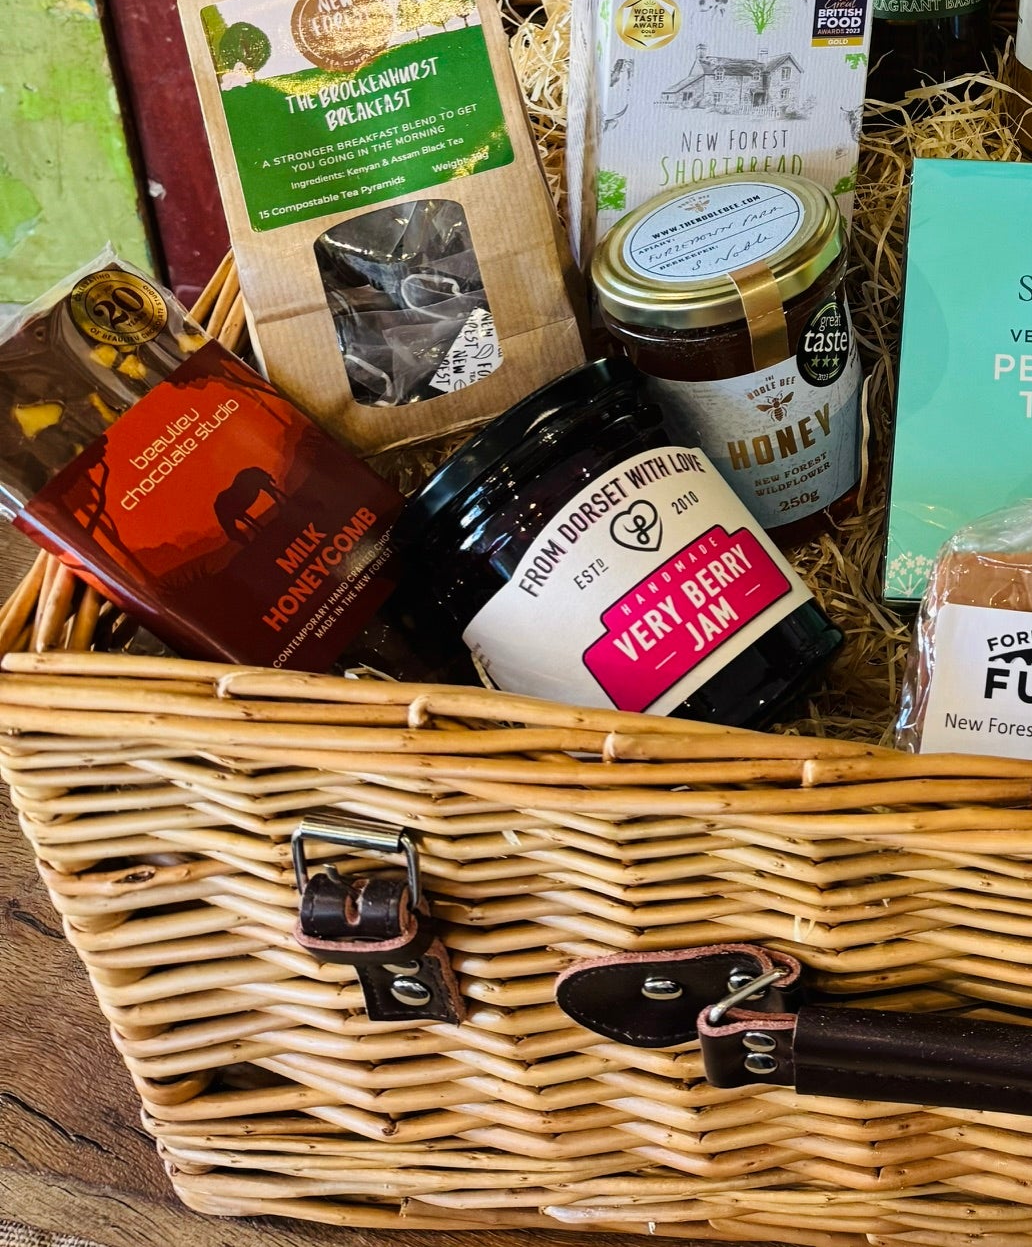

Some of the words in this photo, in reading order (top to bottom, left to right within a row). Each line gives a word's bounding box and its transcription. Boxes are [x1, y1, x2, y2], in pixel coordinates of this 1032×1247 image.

[817, 17, 861, 29] FOOD
[818, 8, 863, 18] BRITISH
[827, 38, 849, 46] GOLD
[284, 94, 317, 114] THE
[319, 57, 440, 107] BROCKENHURST
[325, 88, 412, 132] BREAKFAST
[262, 160, 271, 169] A
[272, 144, 334, 165] STRONGER
[337, 126, 399, 151] BREAKFAST
[402, 115, 437, 134] BLEND
[440, 110, 454, 121] TO
[457, 103, 478, 116] GET
[681, 130, 719, 153] NEW
[729, 129, 789, 150] FOREST
[258, 210, 270, 220] 15
[271, 194, 339, 217] Compostable
[339, 189, 360, 199] Tea
[360, 175, 406, 196] Pyramids
[804, 330, 848, 353] taste
[818, 314, 842, 331] great
[120, 435, 198, 511] chocolate
[194, 398, 240, 442] studio
[129, 408, 200, 470] beaulieu
[727, 403, 831, 471] HONEY
[754, 474, 780, 487] NEW
[784, 452, 827, 478] FOREST
[755, 461, 831, 497] WILDFLOWER
[779, 489, 820, 512] 250g
[518, 541, 568, 598] FROM
[557, 476, 629, 544] DORSET
[624, 458, 670, 491] WITH
[671, 453, 707, 475] LOVE
[261, 506, 377, 632] HONEYCOMB
[275, 522, 327, 576] MILK
[620, 536, 719, 616] HANDMADE
[612, 596, 684, 663] VERY
[680, 543, 753, 610] BERRY
[685, 596, 739, 652] JAM
[944, 713, 983, 731] New
